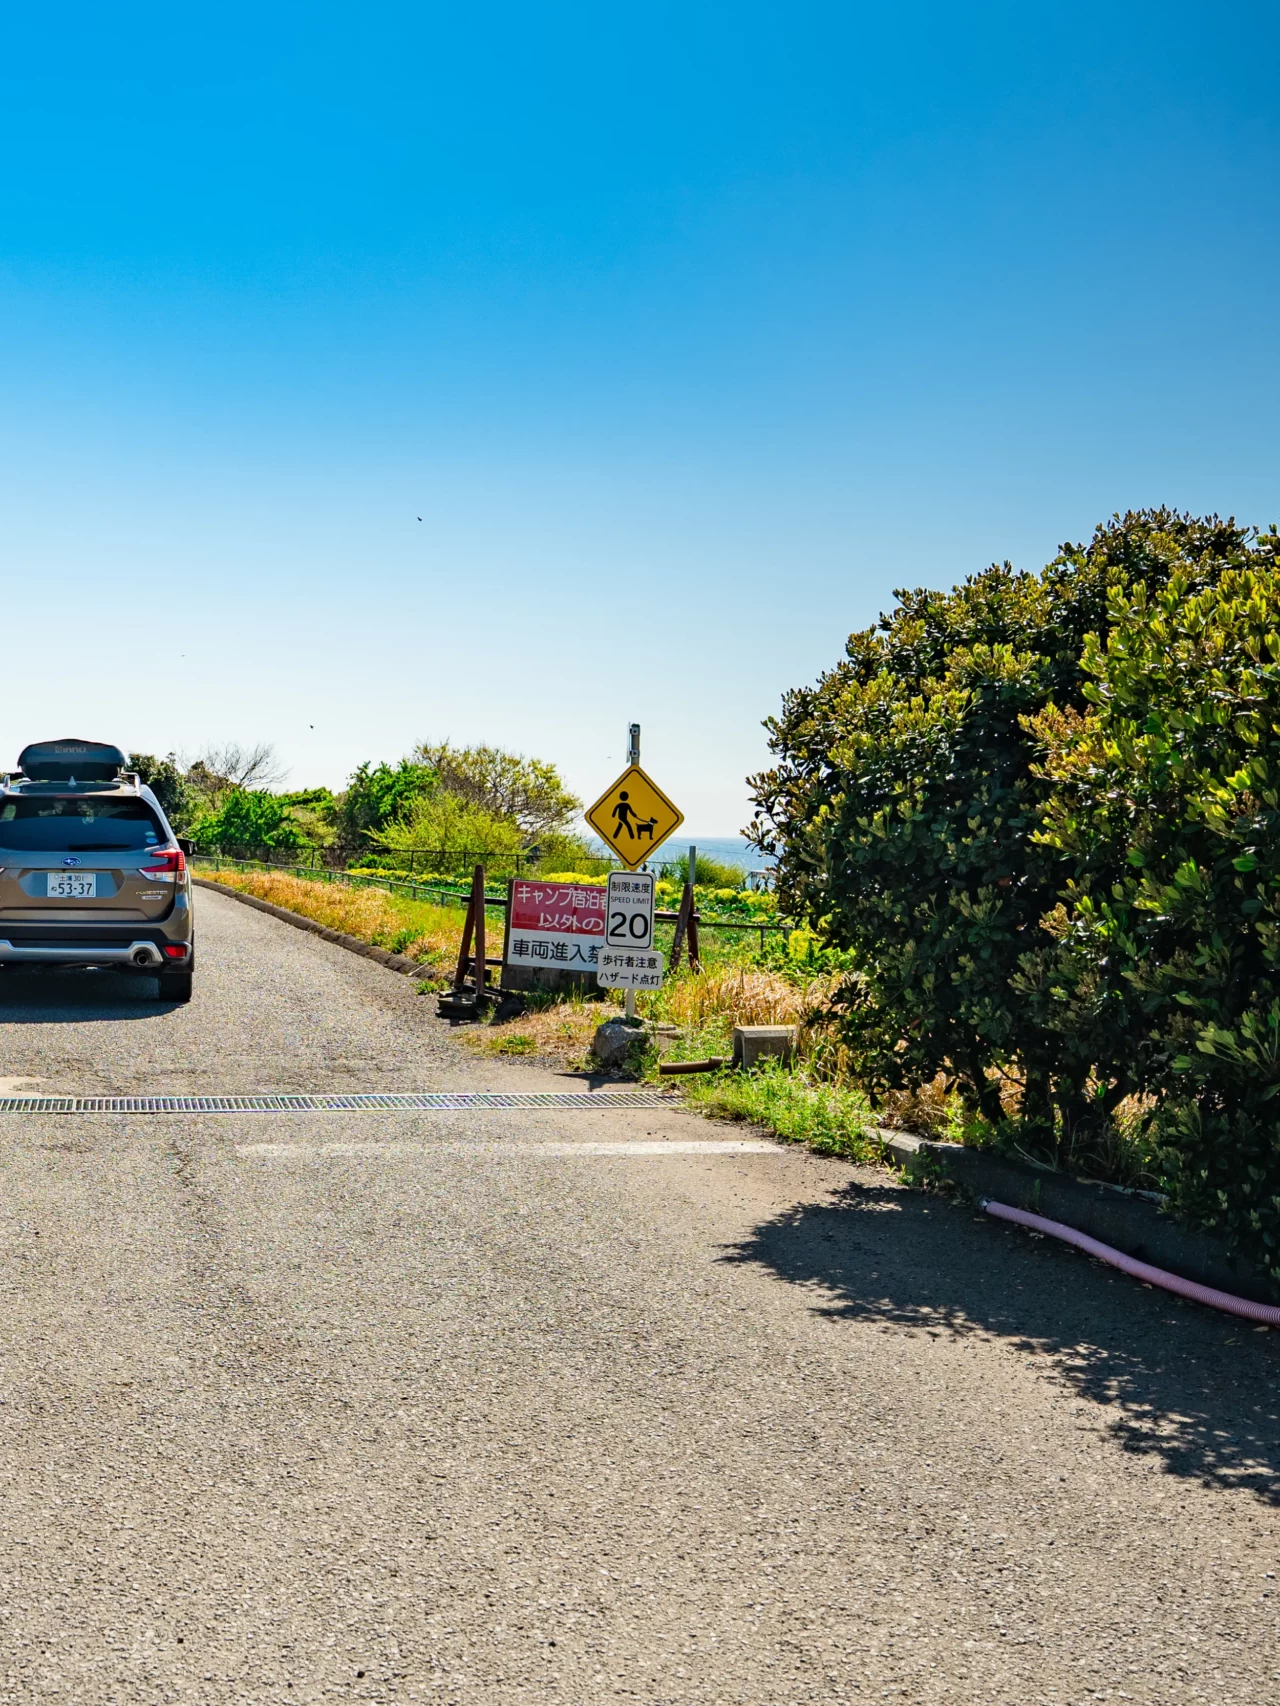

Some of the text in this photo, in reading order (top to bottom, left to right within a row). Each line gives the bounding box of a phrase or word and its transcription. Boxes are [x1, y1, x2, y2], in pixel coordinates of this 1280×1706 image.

[58, 882, 93, 895] 53-37
[611, 881, 651, 894] 制限速度
[610, 896, 650, 905] SPEED LIMIT
[538, 912, 604, 932] 以外の
[609, 911, 649, 940] 20
[602, 954, 658, 969] 歩行者注意
[599, 971, 661, 986] ハザード点灯
